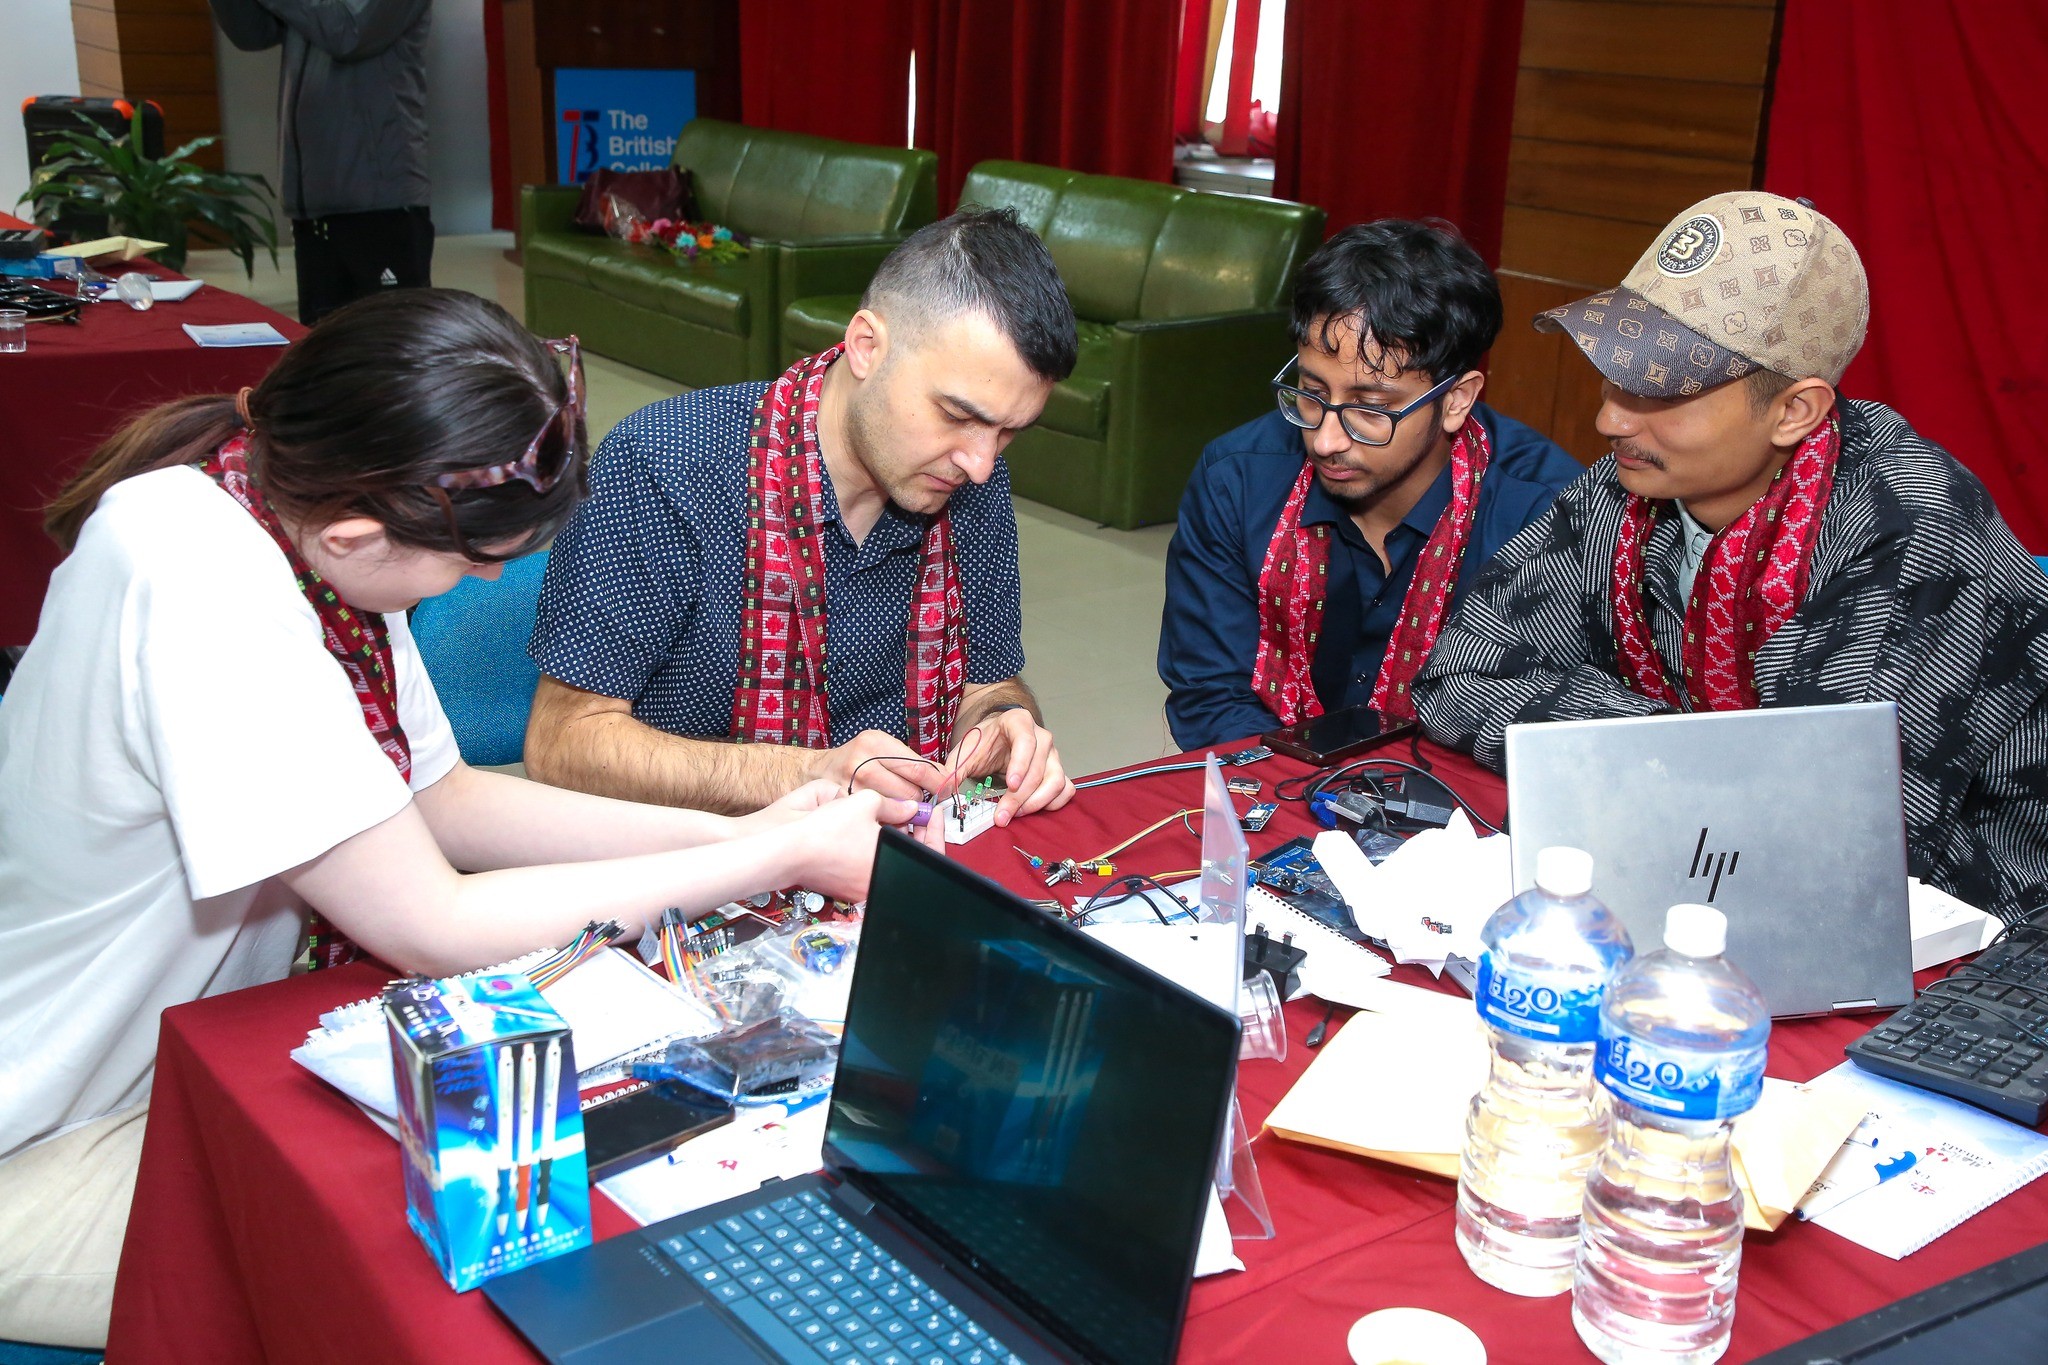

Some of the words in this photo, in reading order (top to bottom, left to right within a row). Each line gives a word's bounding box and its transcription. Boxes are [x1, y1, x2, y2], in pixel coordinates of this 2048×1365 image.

[608, 109, 648, 130] The
[609, 135, 677, 156] British
[1687, 242, 1714, 268] FASHION
[1689, 827, 1740, 903] hp
[1489, 971, 1562, 1017] H2O
[752, 1243, 765, 1253] A
